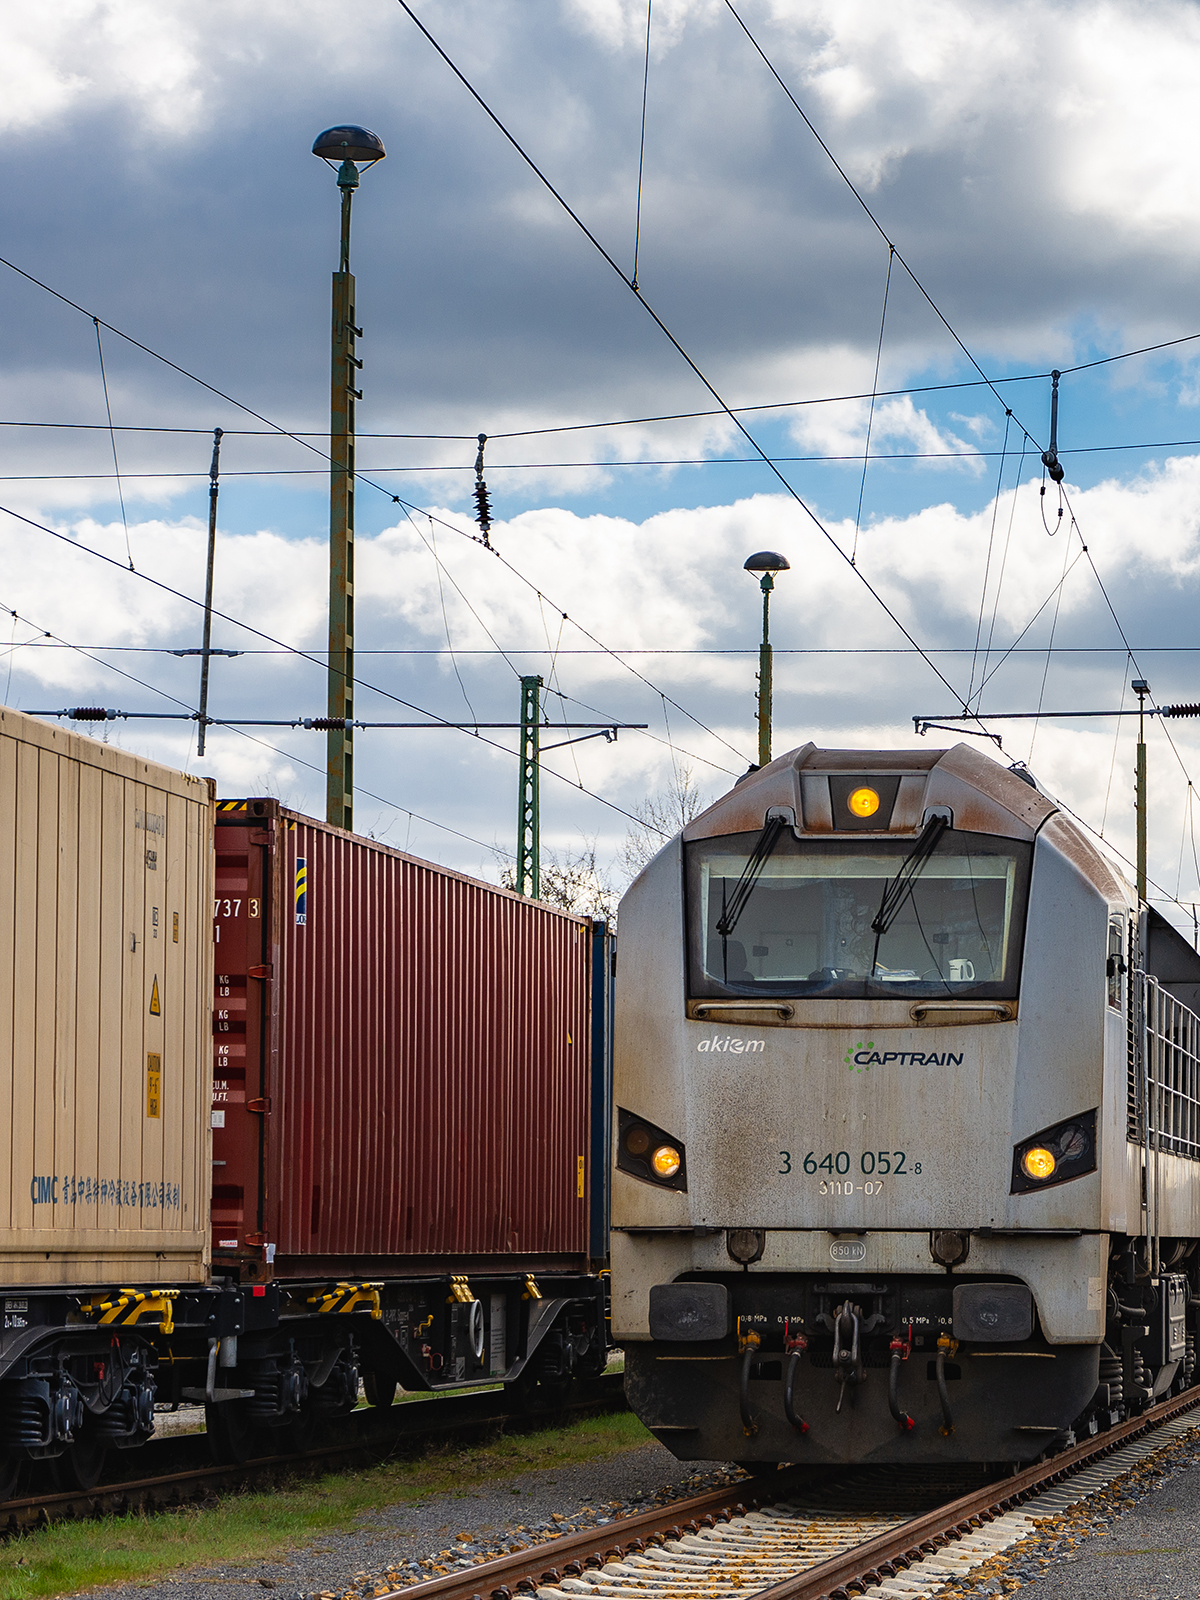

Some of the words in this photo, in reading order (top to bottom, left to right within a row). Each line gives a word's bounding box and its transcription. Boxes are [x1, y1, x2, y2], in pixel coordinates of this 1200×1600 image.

[219, 975, 230, 984] KG
[219, 987, 230, 997] LB
[218, 1010, 229, 1020] KG
[218, 1021, 229, 1031] LB
[218, 1045, 229, 1055] KG
[218, 1057, 229, 1067] LB
[853, 1051, 964, 1067] CAPTRAIN
[778, 1151, 791, 1175] 3
[803, 1151, 851, 1175] 640
[30, 1176, 59, 1204] CIMC
[819, 1181, 883, 1196] 311D-07
[832, 1245, 849, 1257] 850
[851, 1244, 864, 1257] kN
